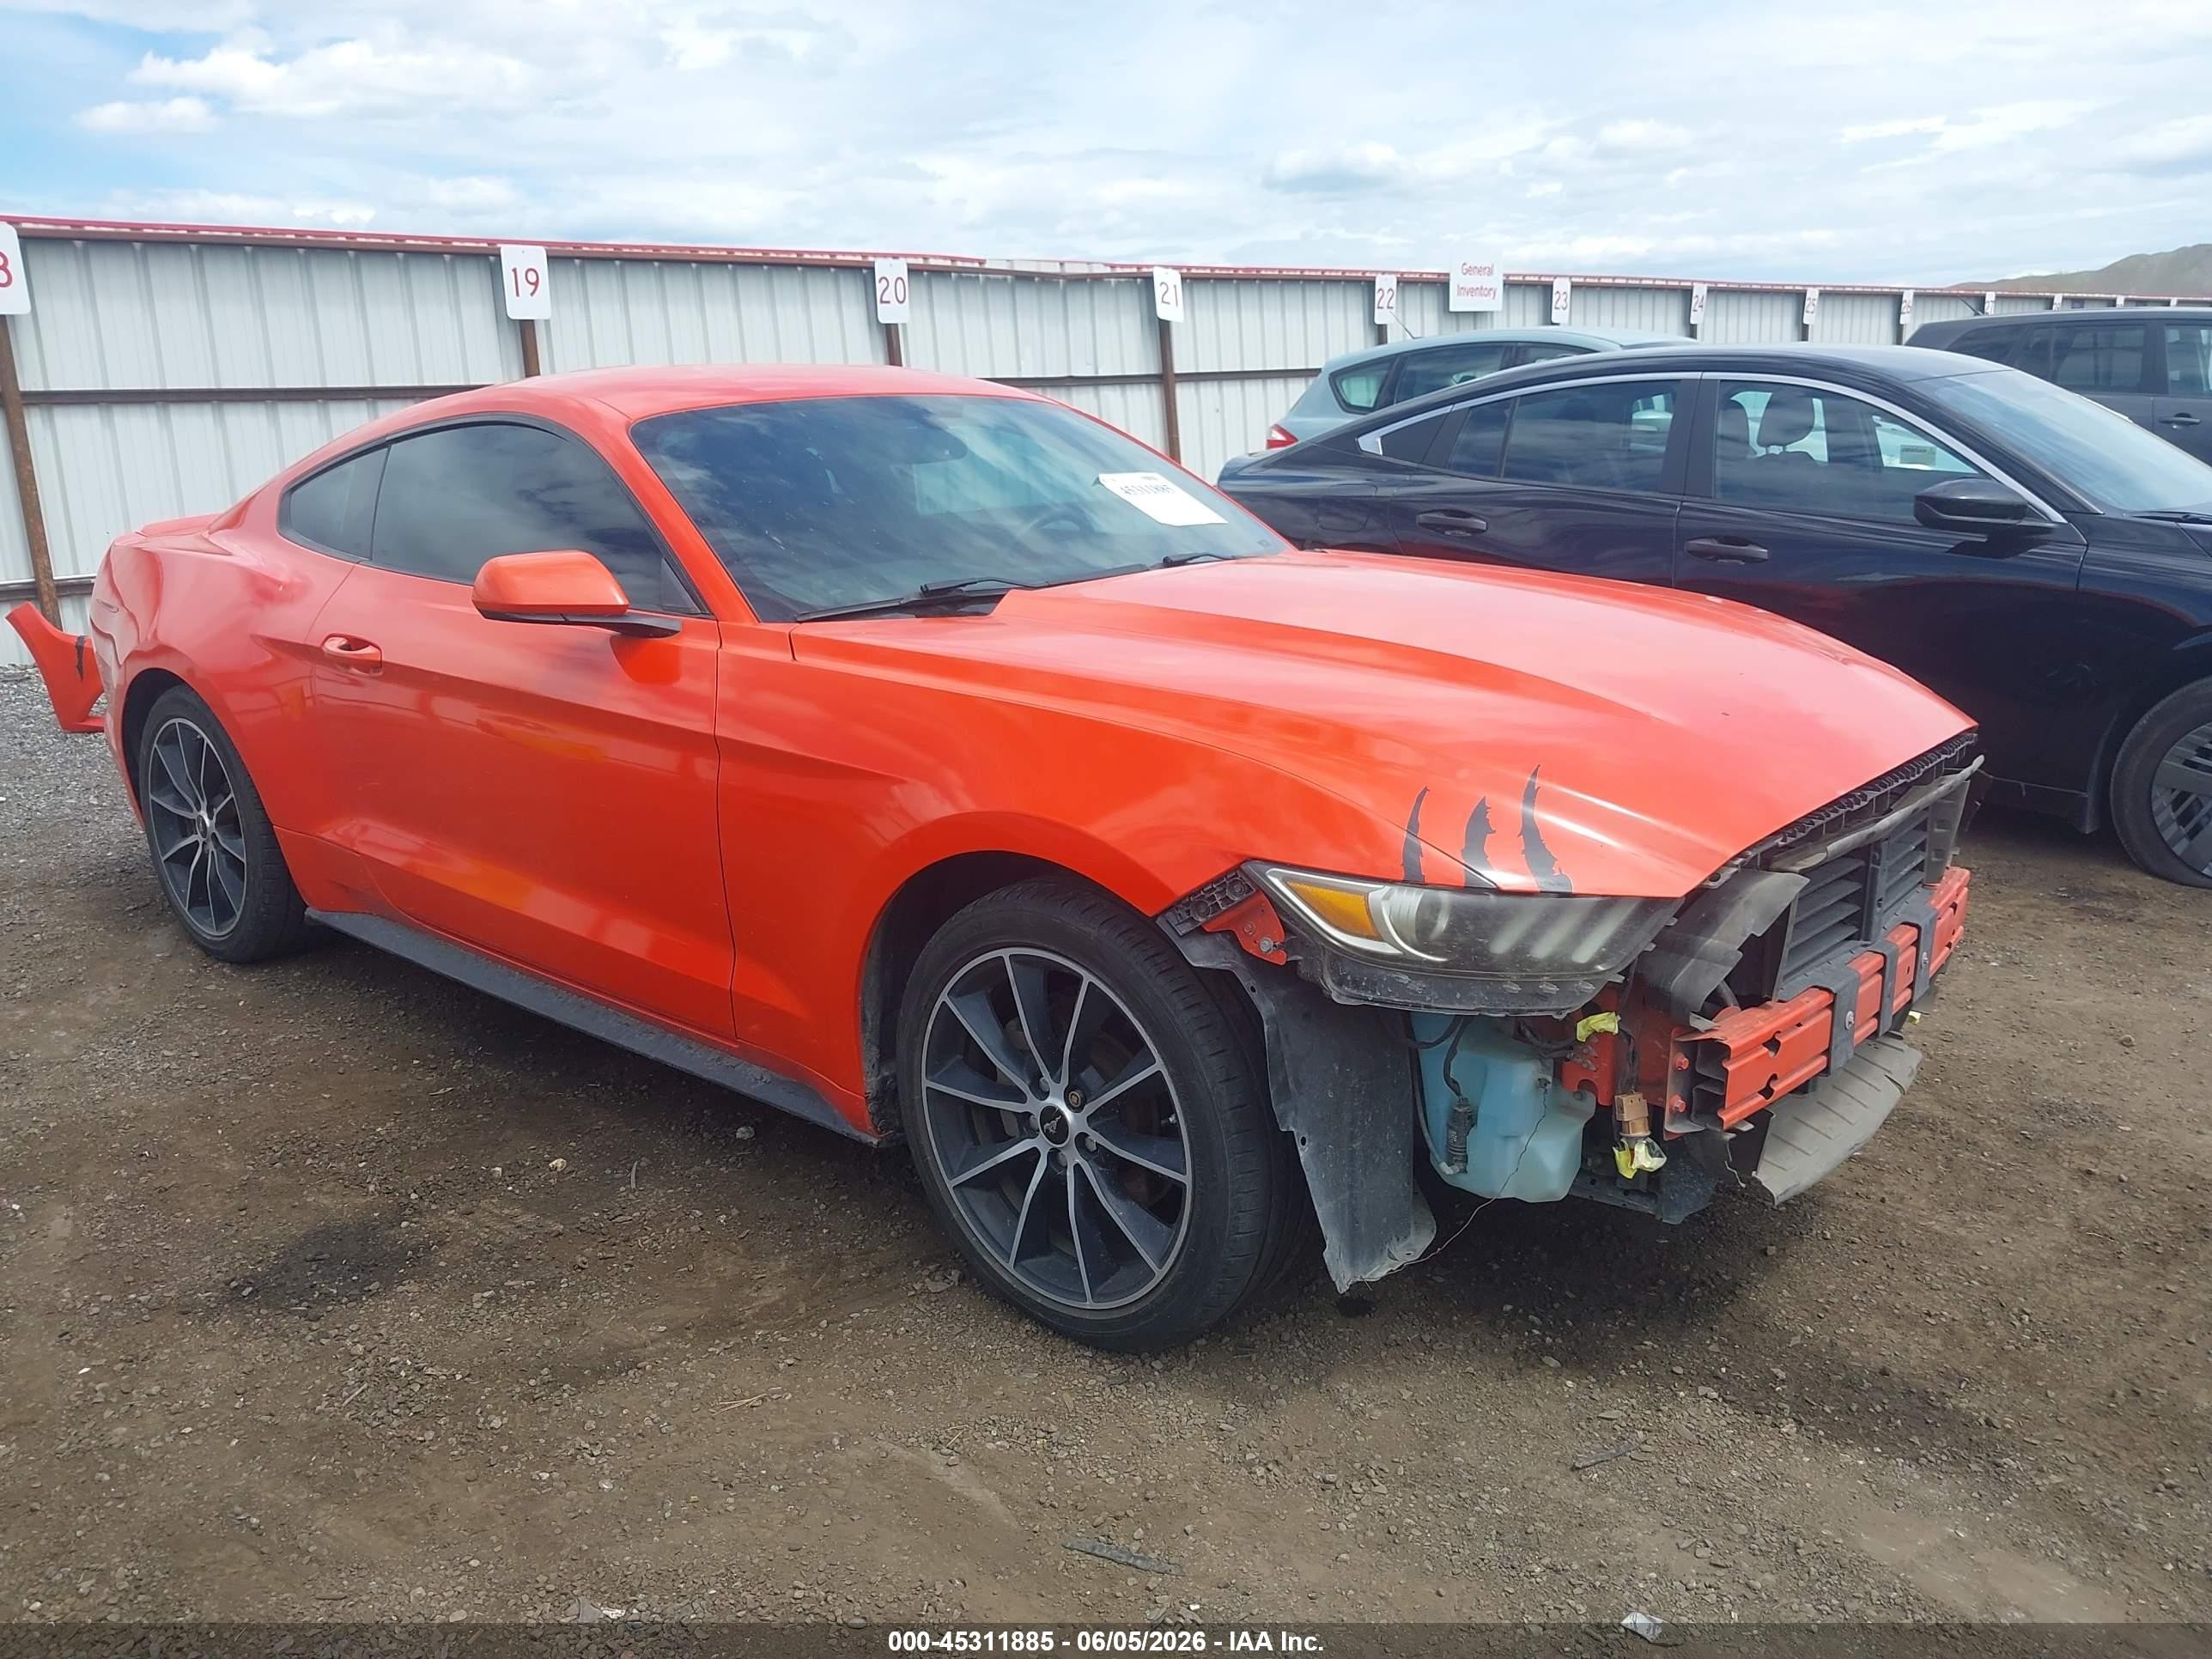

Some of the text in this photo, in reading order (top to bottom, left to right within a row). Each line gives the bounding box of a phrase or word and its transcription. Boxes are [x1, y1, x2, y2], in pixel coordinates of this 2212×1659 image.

[1462, 262, 1494, 276] General
[511, 267, 540, 298] 19
[878, 276, 907, 305] 20
[1456, 284, 1498, 300] Inventory
[1159, 281, 1180, 308] 21
[1376, 288, 1395, 311] 22
[1553, 290, 1568, 311] 23
[1692, 294, 1705, 313] 24
